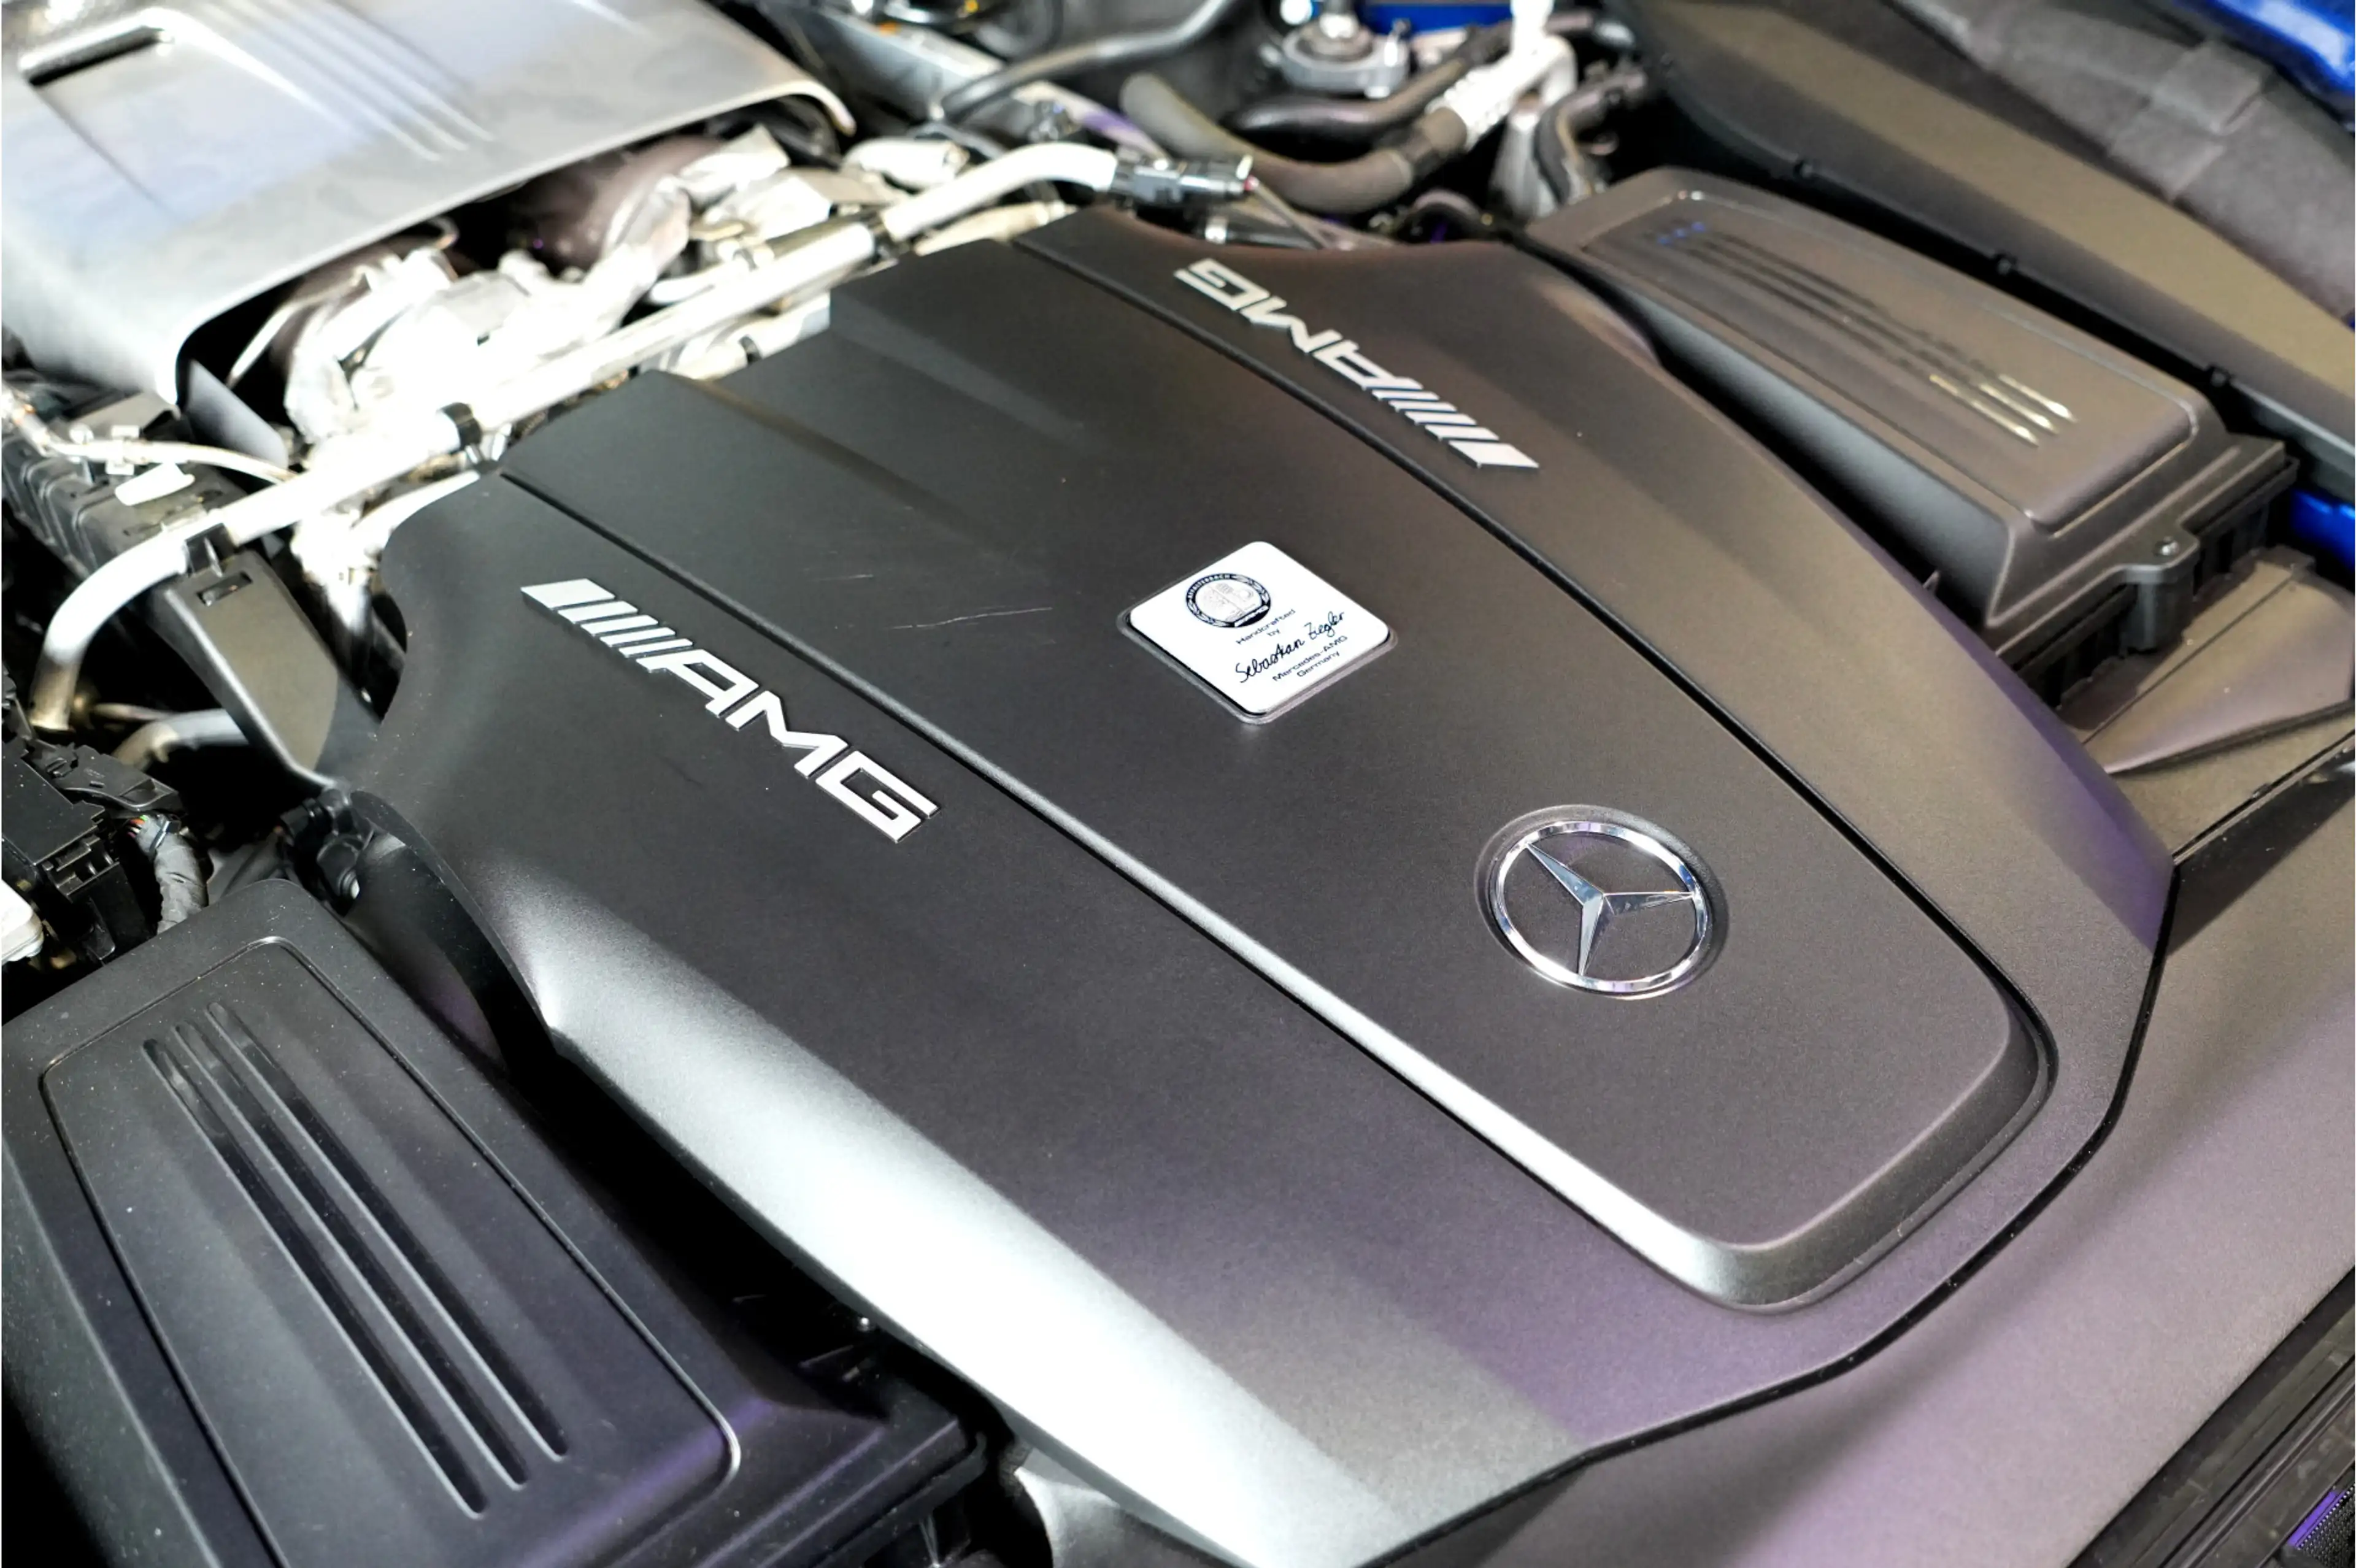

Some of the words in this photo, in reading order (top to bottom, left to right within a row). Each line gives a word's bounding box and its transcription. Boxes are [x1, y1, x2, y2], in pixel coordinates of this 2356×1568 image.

[1236, 609, 1296, 645] Handcrafted
[1236, 639, 1305, 683] Sebastian
[1304, 611, 1344, 640] Ziegler
[1272, 636, 1347, 682] Mercedes-AMG
[1296, 651, 1340, 677] Germany
[636, 649, 939, 844] AMG
